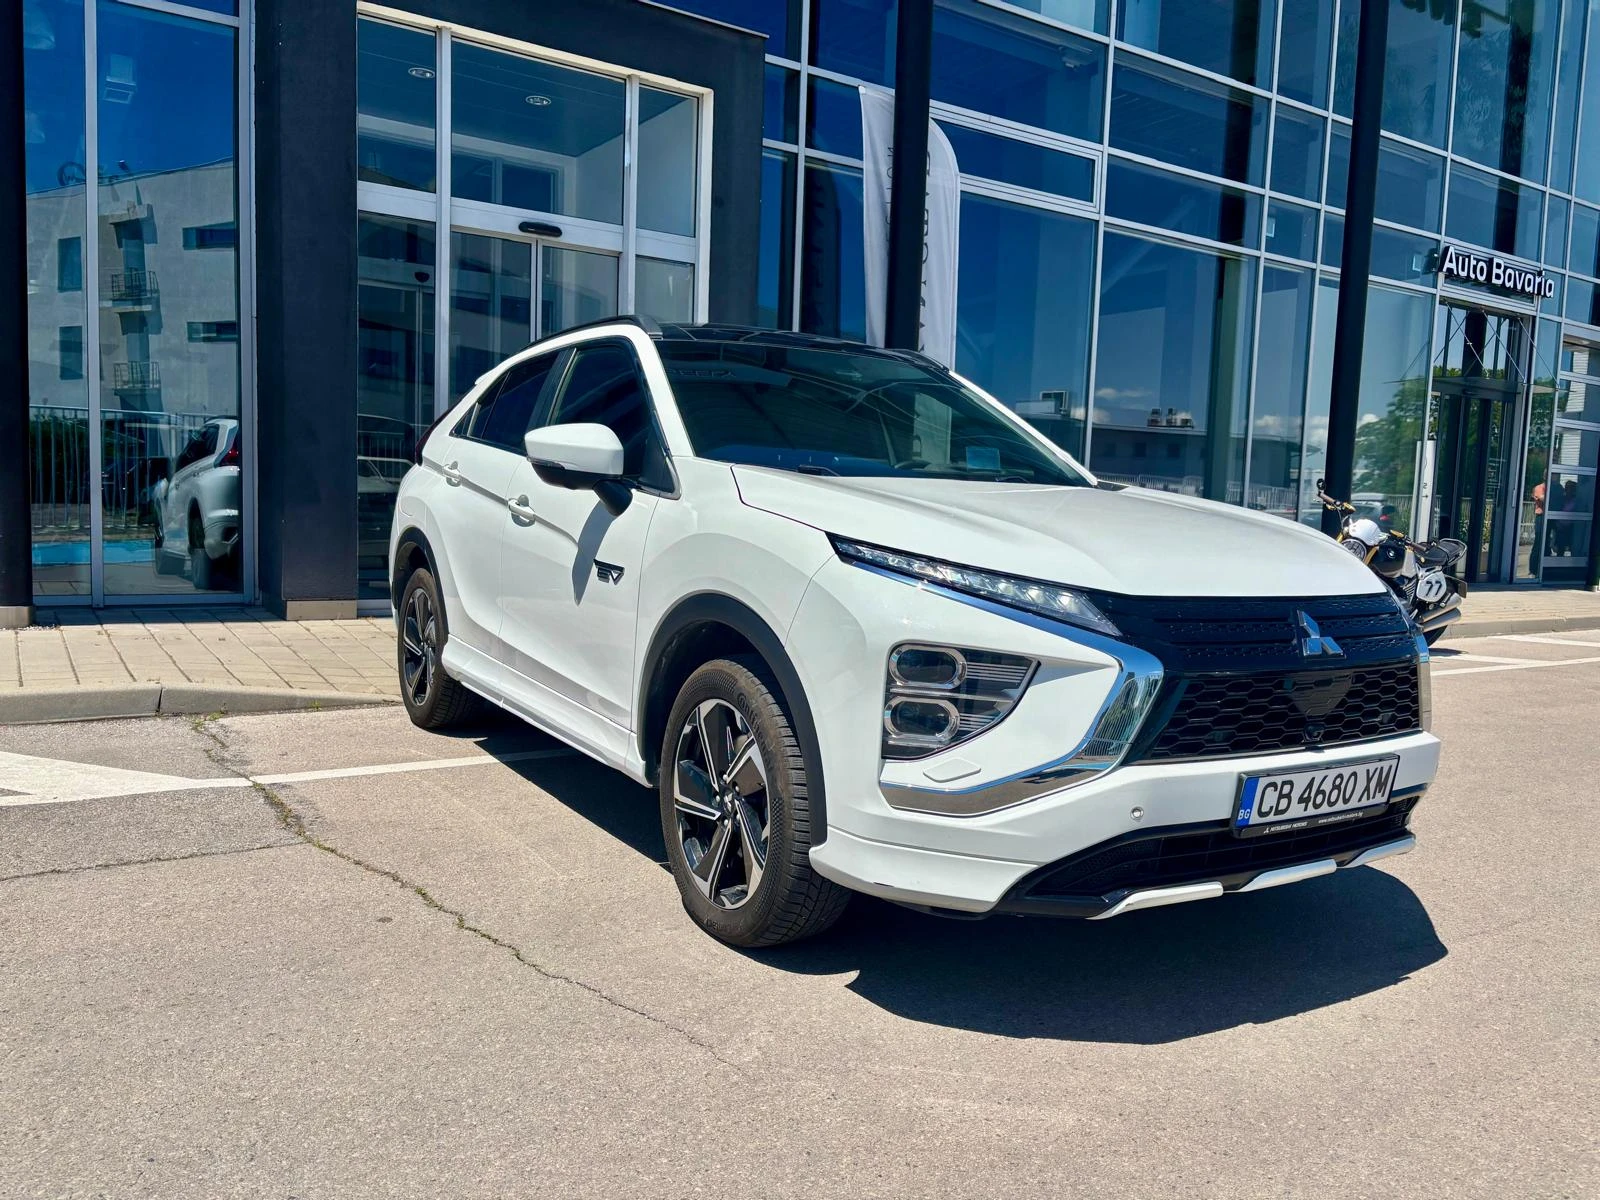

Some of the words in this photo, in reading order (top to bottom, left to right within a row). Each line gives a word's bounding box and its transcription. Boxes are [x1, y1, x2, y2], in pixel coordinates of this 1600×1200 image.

[1443, 246, 1487, 282] Auto
[1491, 257, 1555, 298] Bavaria
[1425, 580, 1443, 596] 77
[1257, 780, 1294, 818] CB
[1297, 771, 1358, 812] 4680
[1358, 764, 1393, 803] XM
[1238, 808, 1251, 820] BG
